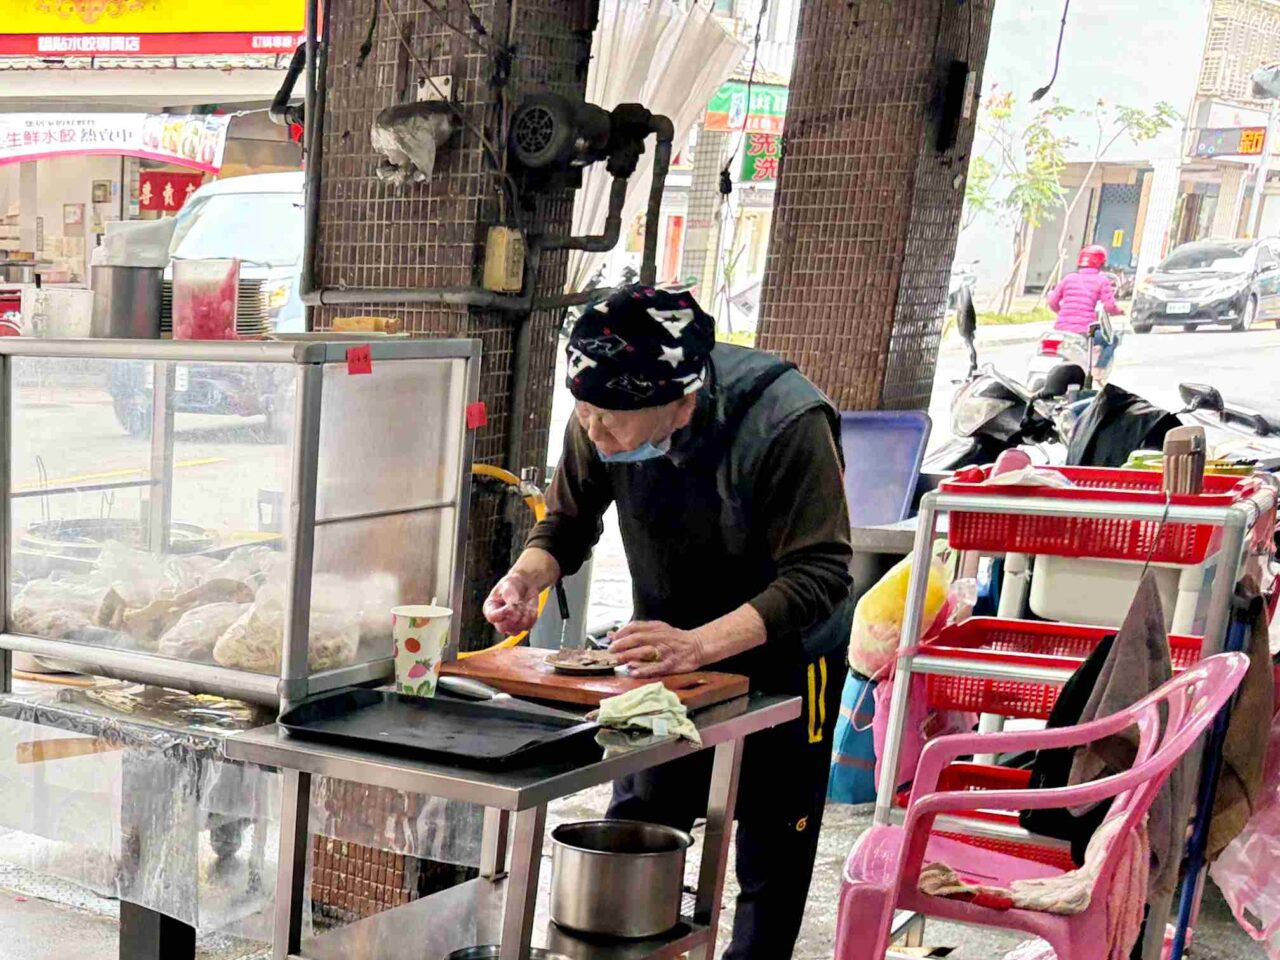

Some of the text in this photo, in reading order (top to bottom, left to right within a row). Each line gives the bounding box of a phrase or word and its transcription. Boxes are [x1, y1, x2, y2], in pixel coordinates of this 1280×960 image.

[6, 128, 76, 147] 生鮮水餃
[1238, 129, 1265, 153] 新
